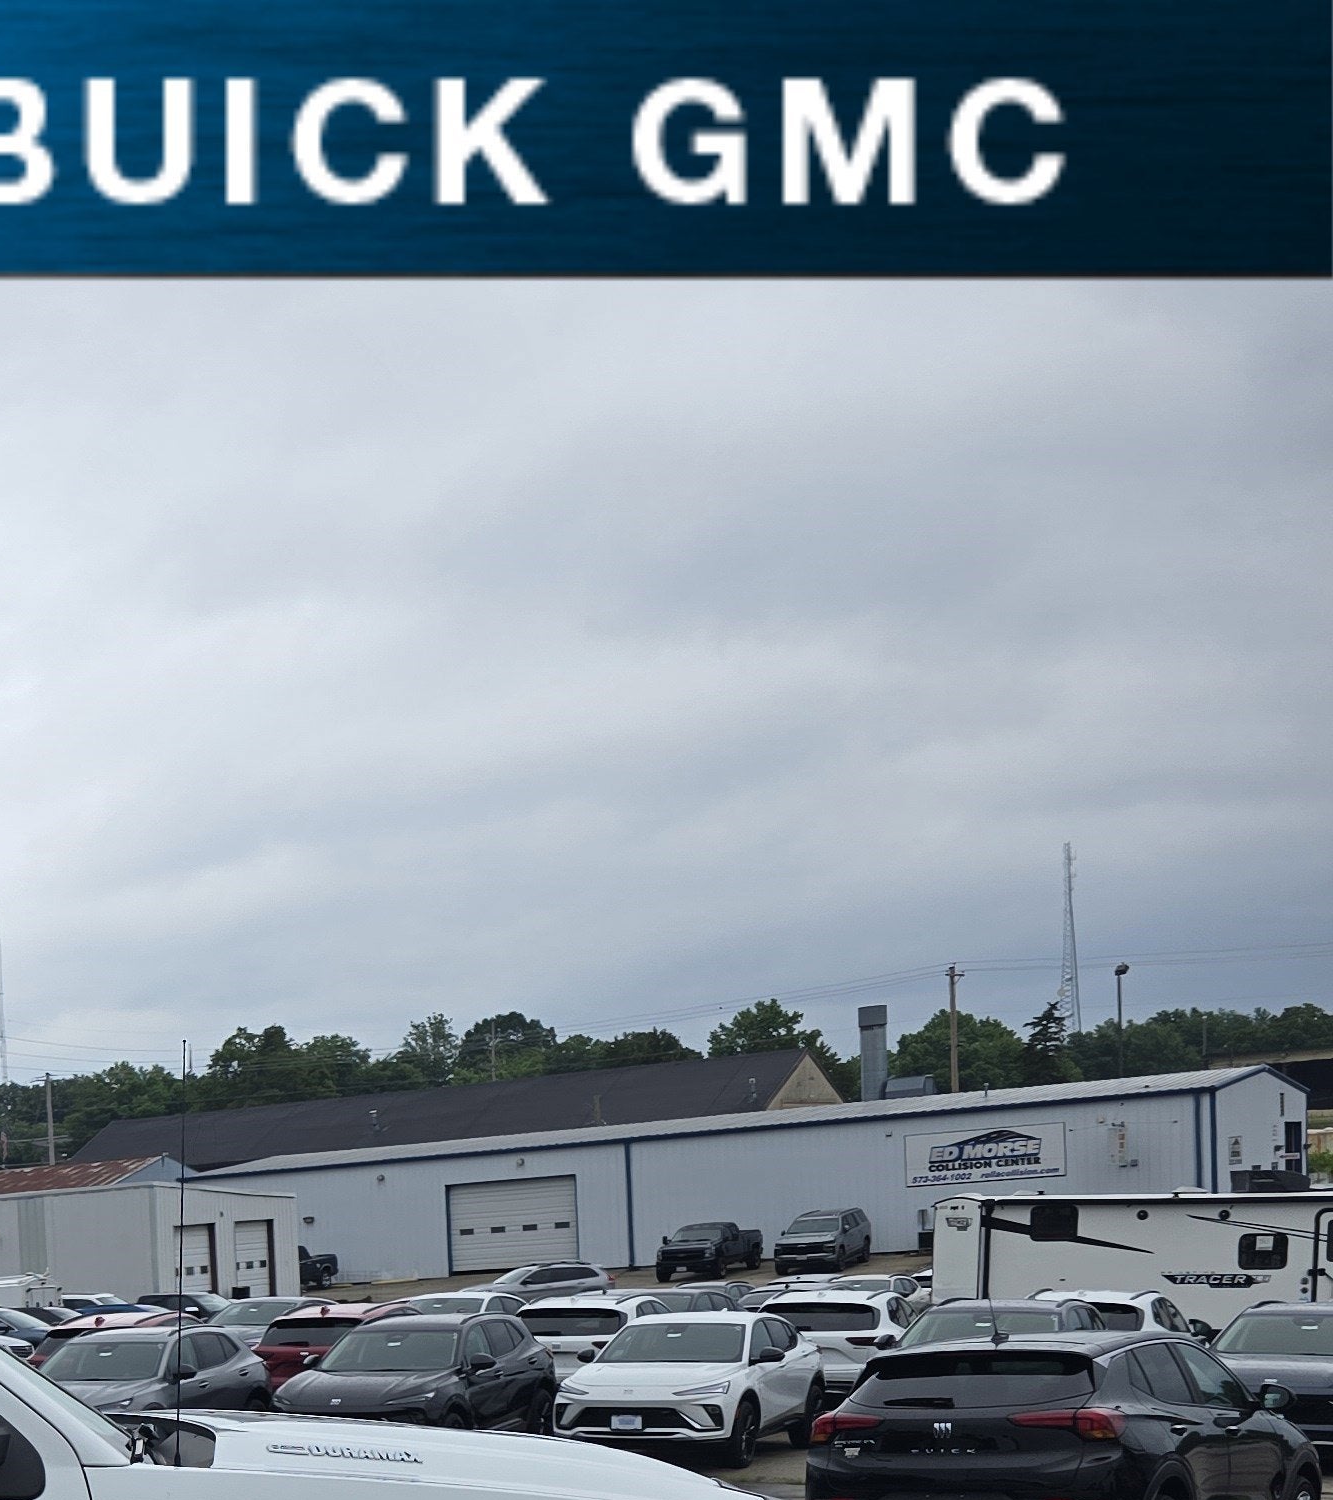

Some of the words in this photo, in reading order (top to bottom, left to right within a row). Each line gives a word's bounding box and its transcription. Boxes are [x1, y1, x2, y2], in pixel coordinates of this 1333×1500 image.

[930, 1147, 959, 1162] ED
[961, 1138, 1041, 1160] MORSE
[928, 1161, 992, 1172] COLLISION
[995, 1157, 1041, 1168] CENTER
[912, 1172, 972, 1184] 573-364-1002
[980, 1167, 1059, 1179] rollacollision.com
[1173, 1275, 1247, 1284] TRACER
[308, 1445, 423, 1464] DURAMAX
